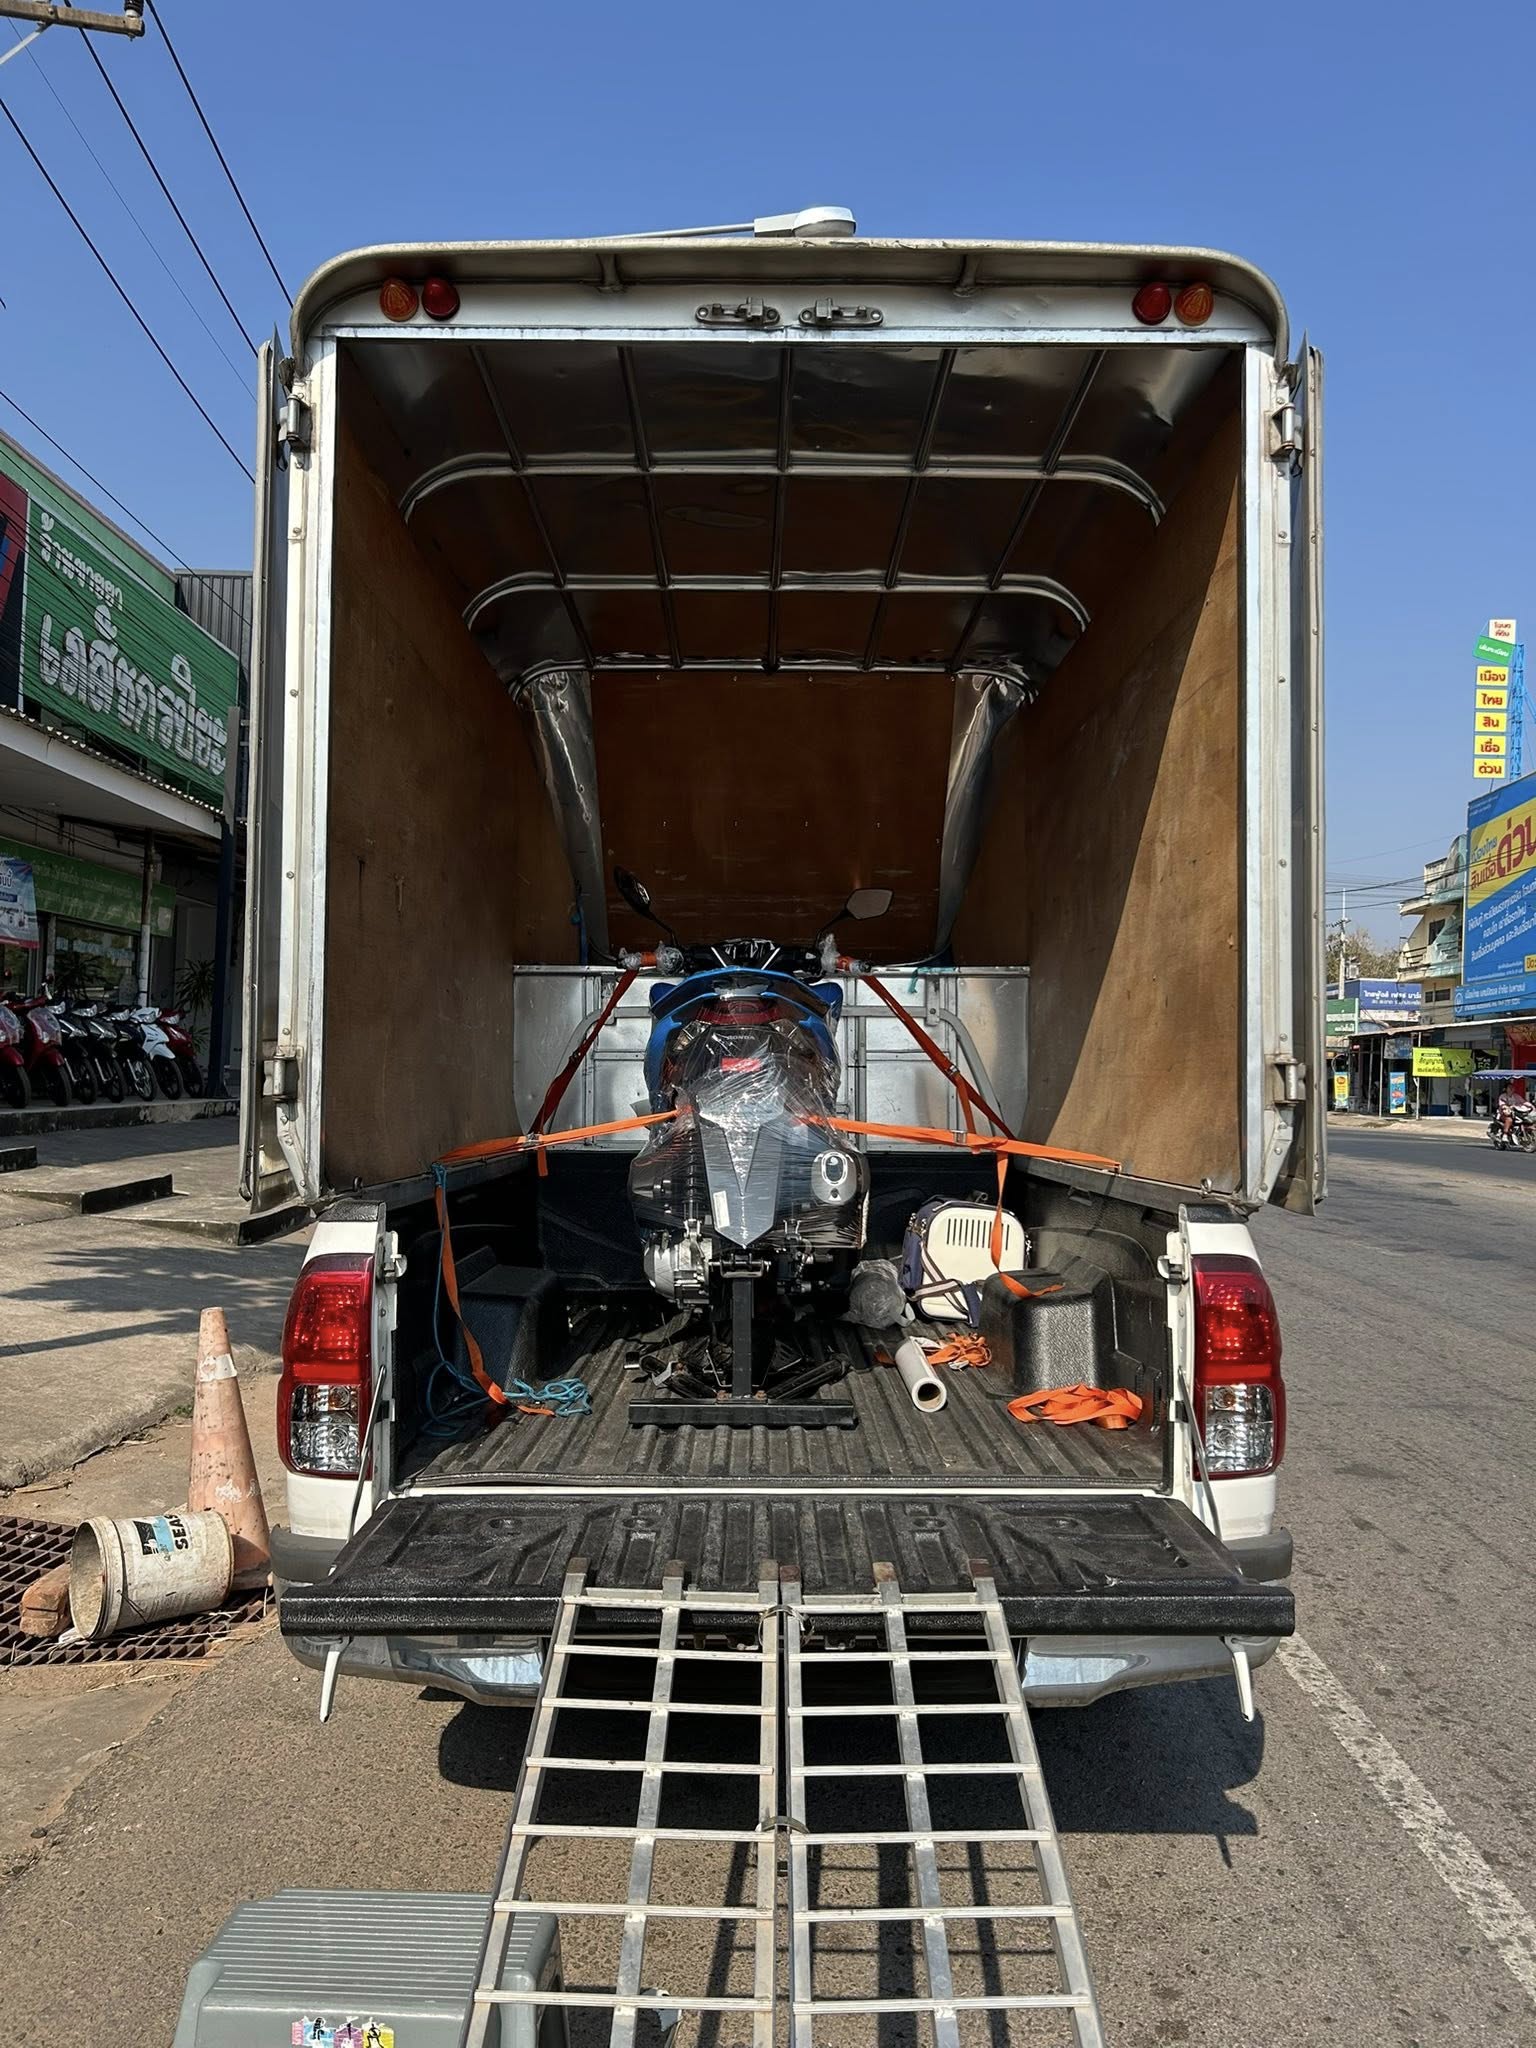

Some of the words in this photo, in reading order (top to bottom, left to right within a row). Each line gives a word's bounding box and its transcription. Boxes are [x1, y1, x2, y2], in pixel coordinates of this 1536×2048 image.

[40, 512, 123, 612] ร้านขายยา
[1480, 670, 1506, 682] เมือง
[1481, 693, 1503, 706] ไทย
[1482, 716, 1500, 728] สิน
[1480, 738, 1500, 753] เชื่อ
[1478, 762, 1502, 774] ด่วน
